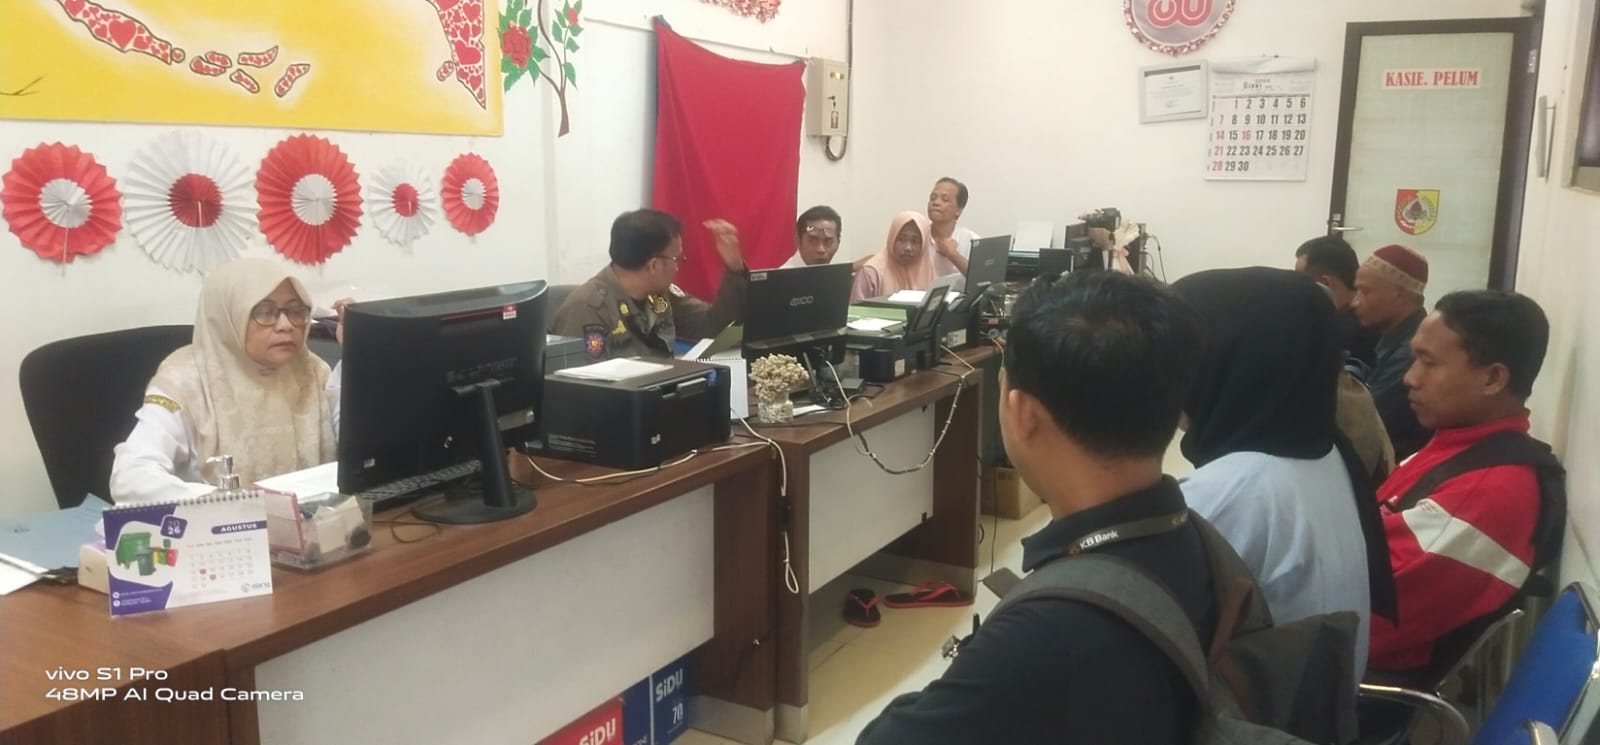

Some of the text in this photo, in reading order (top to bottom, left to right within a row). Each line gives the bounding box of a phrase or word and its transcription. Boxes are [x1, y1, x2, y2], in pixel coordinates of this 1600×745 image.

[1385, 71, 1478, 87] KASIE. PELUM
[1235, 98, 1306, 109] 1 2 3 4 5 6
[1219, 114, 1306, 125] 7 8 9 10 11 12 13
[1216, 130, 1305, 140] 14 15 16 17 18 19 20
[1214, 146, 1304, 156] 21 22 23 24 25 26 27
[1212, 161, 1249, 171] 28 29 30
[221, 523, 257, 532] AGUSTUS
[1079, 530, 1119, 550] KB Bank
[656, 668, 683, 702] SiDU
[672, 703, 683, 724] 70
